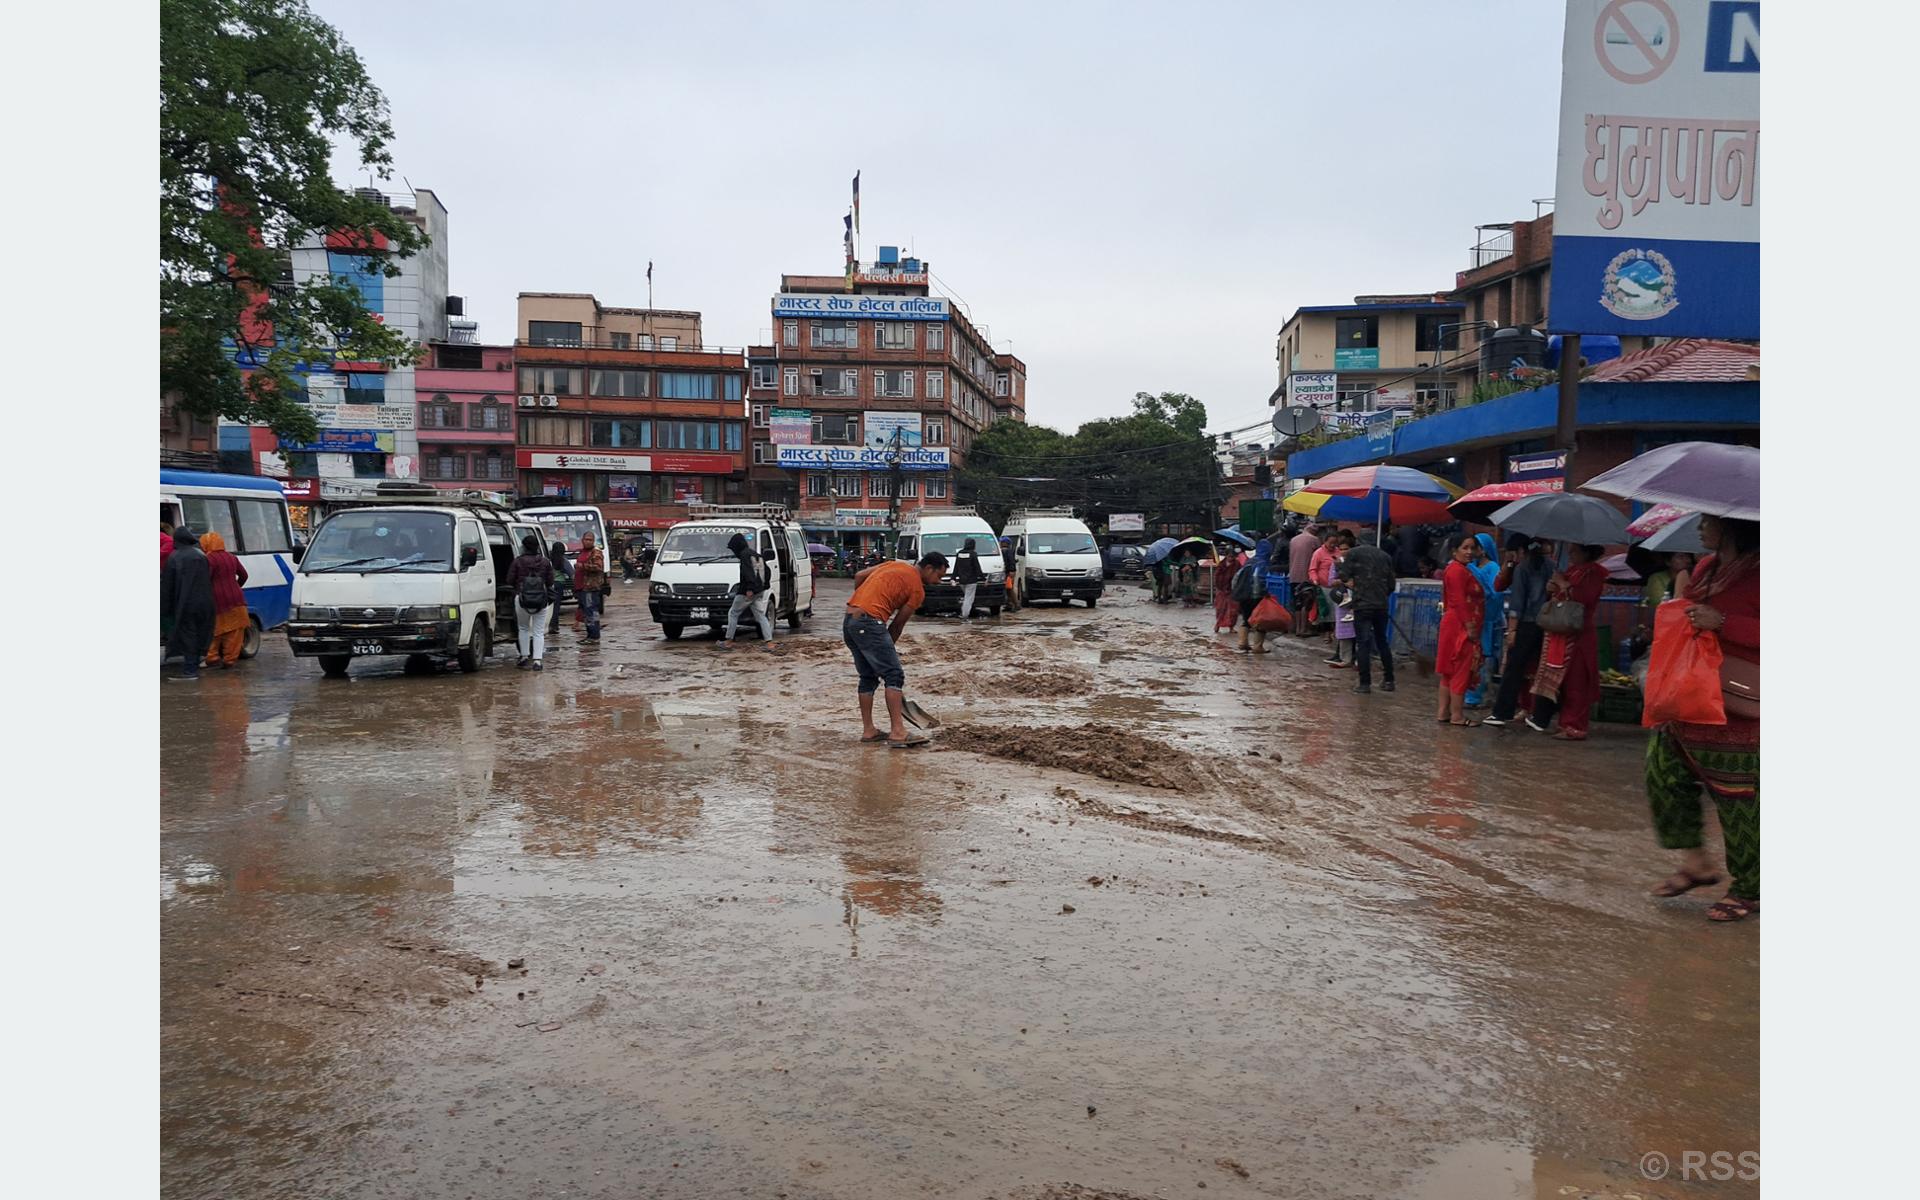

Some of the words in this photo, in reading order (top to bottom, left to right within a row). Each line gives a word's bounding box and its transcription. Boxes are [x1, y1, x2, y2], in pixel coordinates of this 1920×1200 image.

[779, 298, 821, 311] मास्टर
[827, 296, 853, 312] सेफ
[858, 296, 895, 312] होटल
[899, 298, 942, 312] तालिम
[781, 448, 822, 461] मास्टर
[828, 447, 855, 462] सेफ
